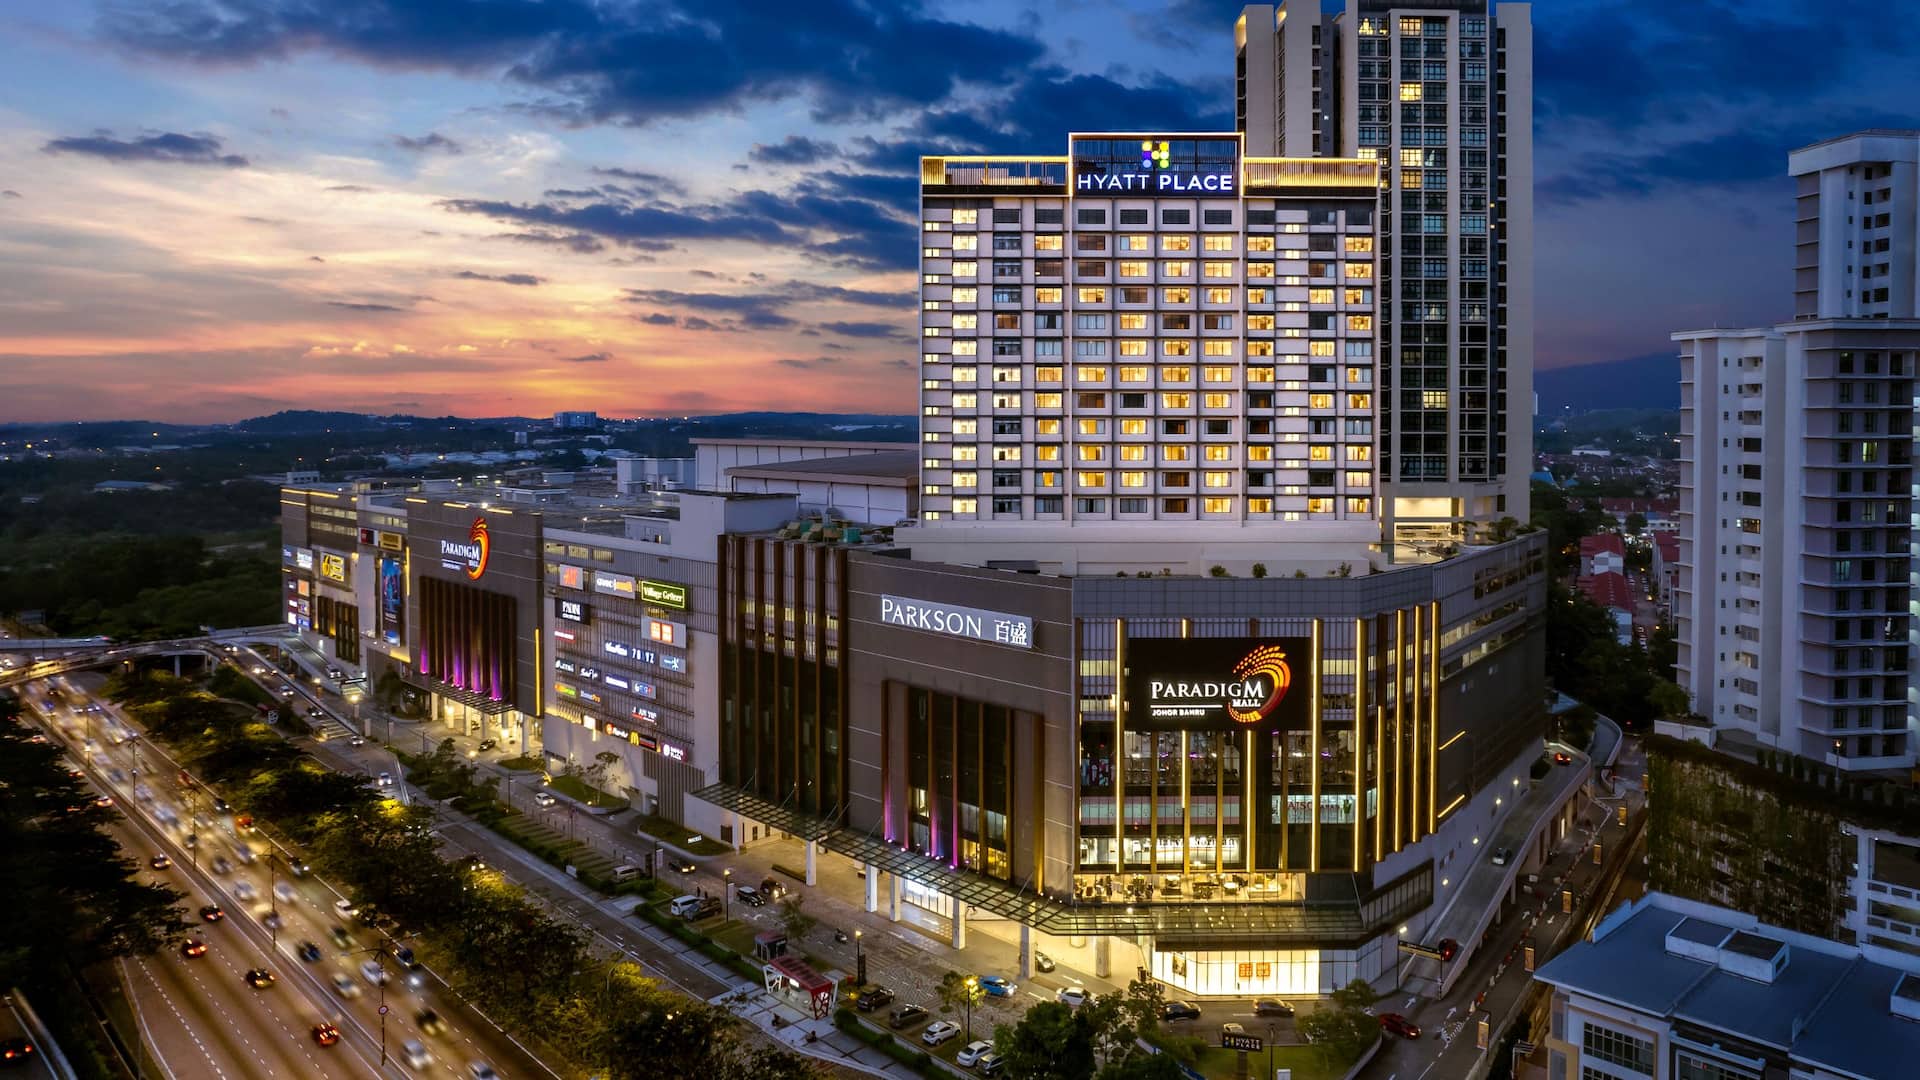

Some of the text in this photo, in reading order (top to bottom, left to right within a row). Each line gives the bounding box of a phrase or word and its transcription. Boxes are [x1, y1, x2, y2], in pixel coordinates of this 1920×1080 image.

[1077, 174, 1233, 191] HYATT PLACE
[441, 540, 480, 561] PARADIGM
[881, 598, 982, 640] PARKSON
[993, 618, 1028, 646] 百盛
[1151, 680, 1265, 699] PARADIGM
[1151, 708, 1206, 717] JOHOR BAHRU
[1232, 698, 1261, 708] MALL
